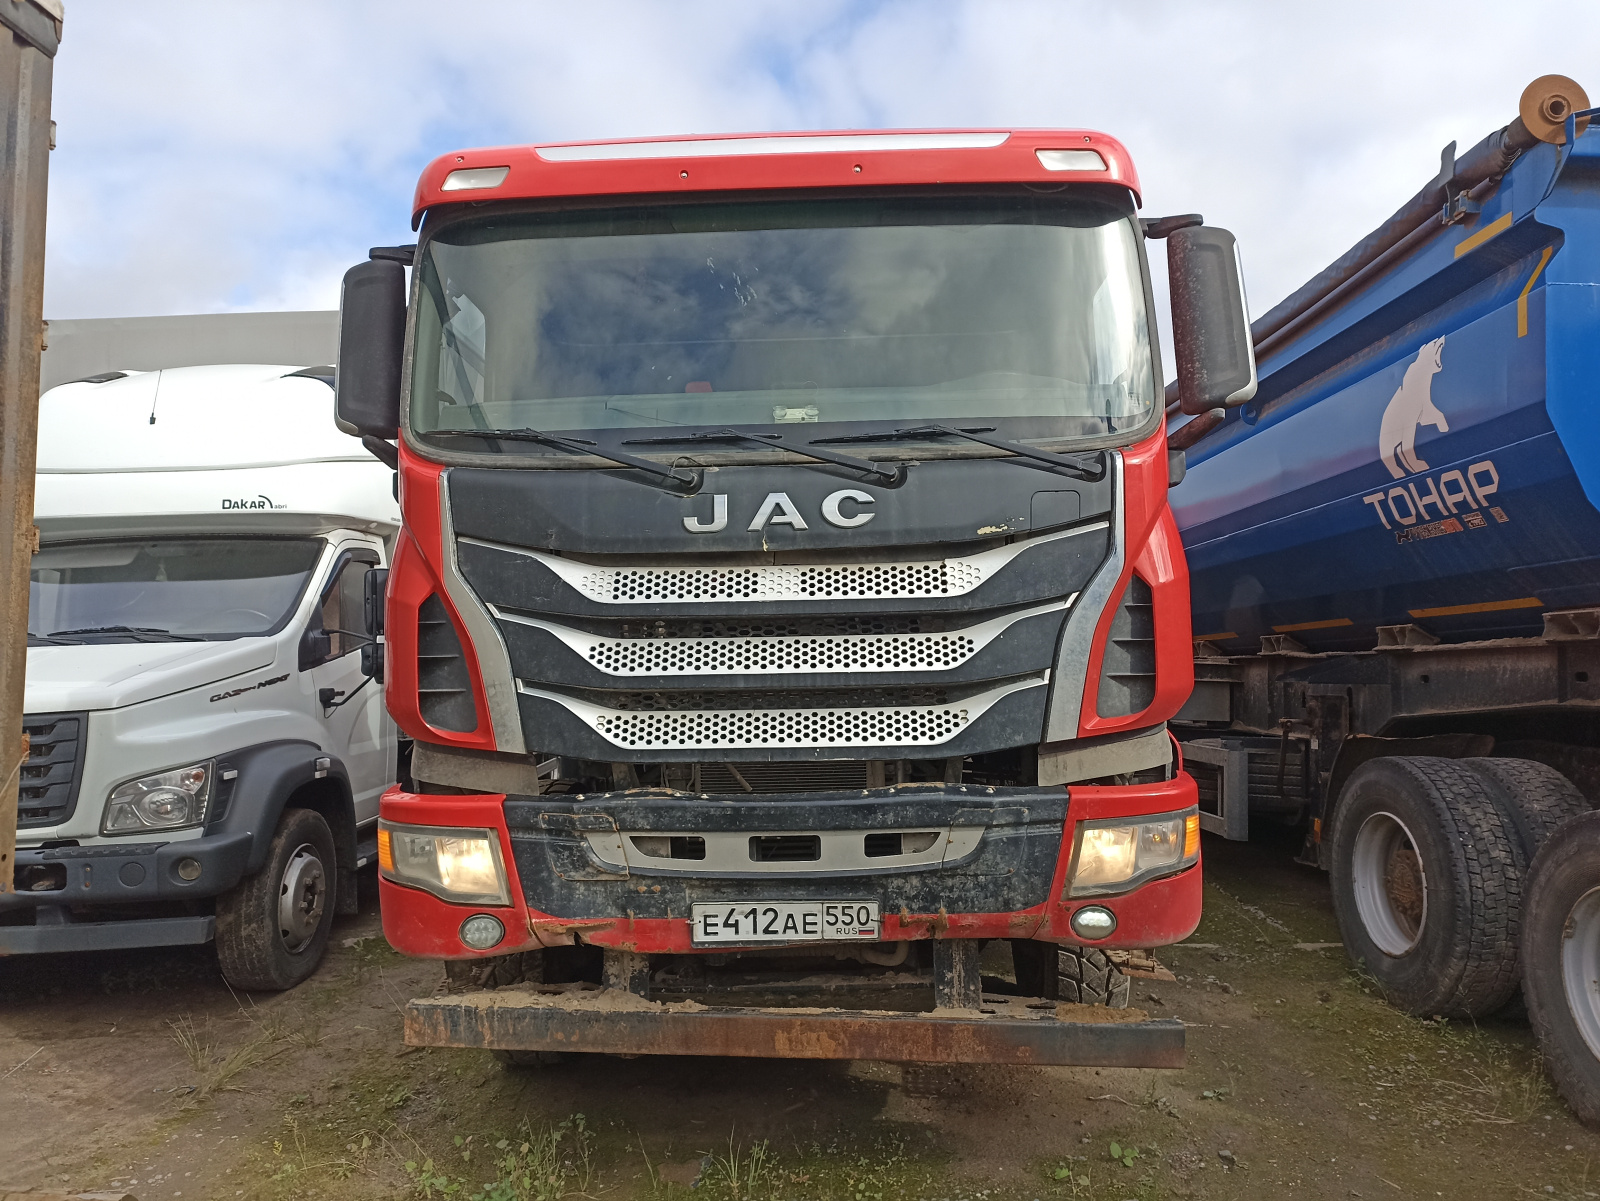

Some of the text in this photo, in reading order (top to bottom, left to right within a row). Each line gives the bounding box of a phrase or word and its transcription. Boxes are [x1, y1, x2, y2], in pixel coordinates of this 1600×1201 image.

[683, 489, 876, 534] JAC
[825, 905, 870, 926] 550
[836, 927, 857, 935] RUS
